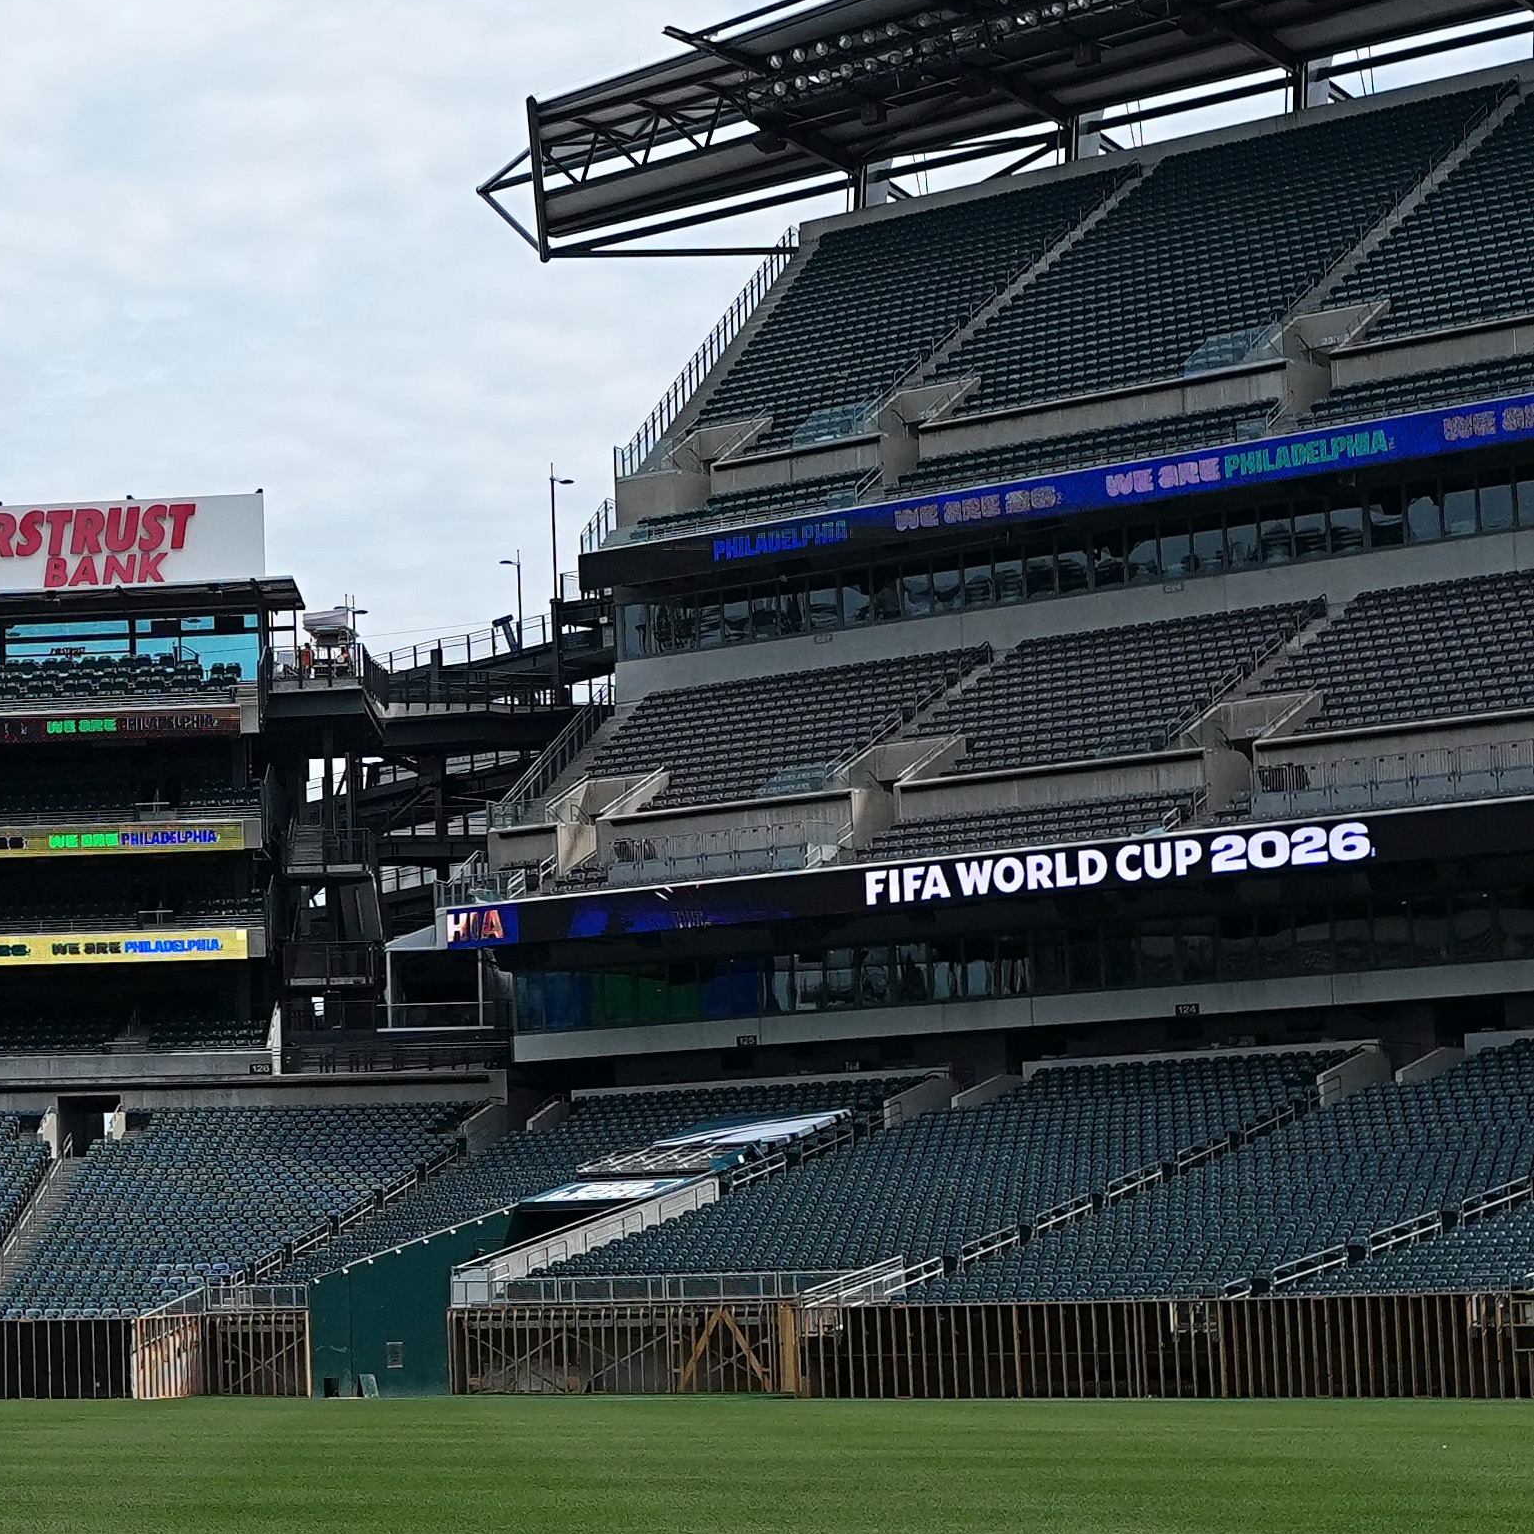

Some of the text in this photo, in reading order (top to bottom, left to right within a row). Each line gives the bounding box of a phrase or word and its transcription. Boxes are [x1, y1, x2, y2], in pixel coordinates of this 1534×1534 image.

[1443, 411, 1497, 441] WE
[1106, 469, 1155, 498] WE
[1225, 429, 1388, 480] PHILADELPHIA
[894, 503, 940, 532] WE
[44, 552, 169, 588] BANK
[47, 720, 76, 733] WE
[121, 829, 217, 846] PHILADELPHIA
[865, 821, 1371, 906] FIFA WORLD CUP 2026
[52, 942, 81, 955] WE
[124, 938, 219, 954] PHILADELPHIA
